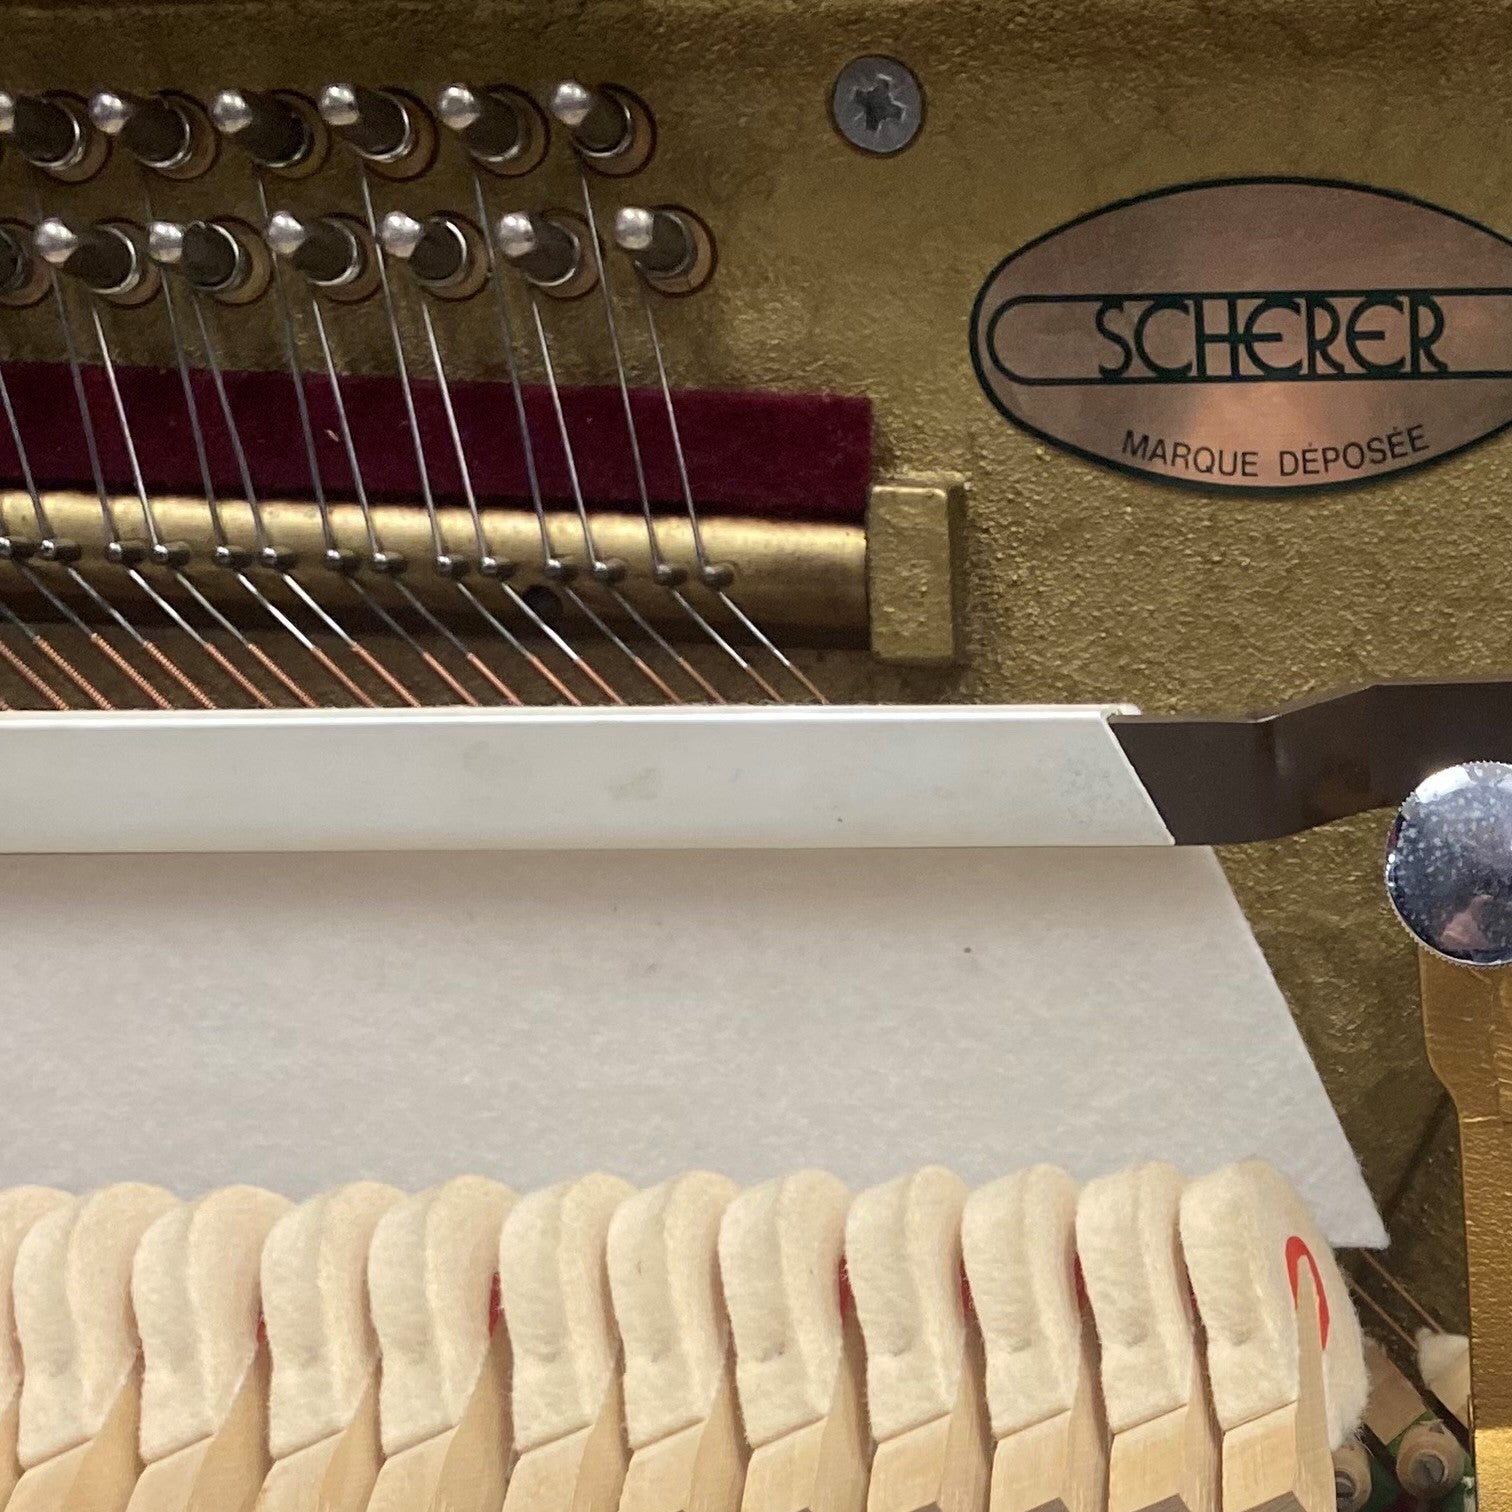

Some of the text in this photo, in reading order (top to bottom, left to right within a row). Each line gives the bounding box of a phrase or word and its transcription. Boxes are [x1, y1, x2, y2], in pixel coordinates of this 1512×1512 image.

[1095, 293, 1448, 379] SCHERER
[1122, 425, 1430, 477] MARQUE DÉPOSÉE
